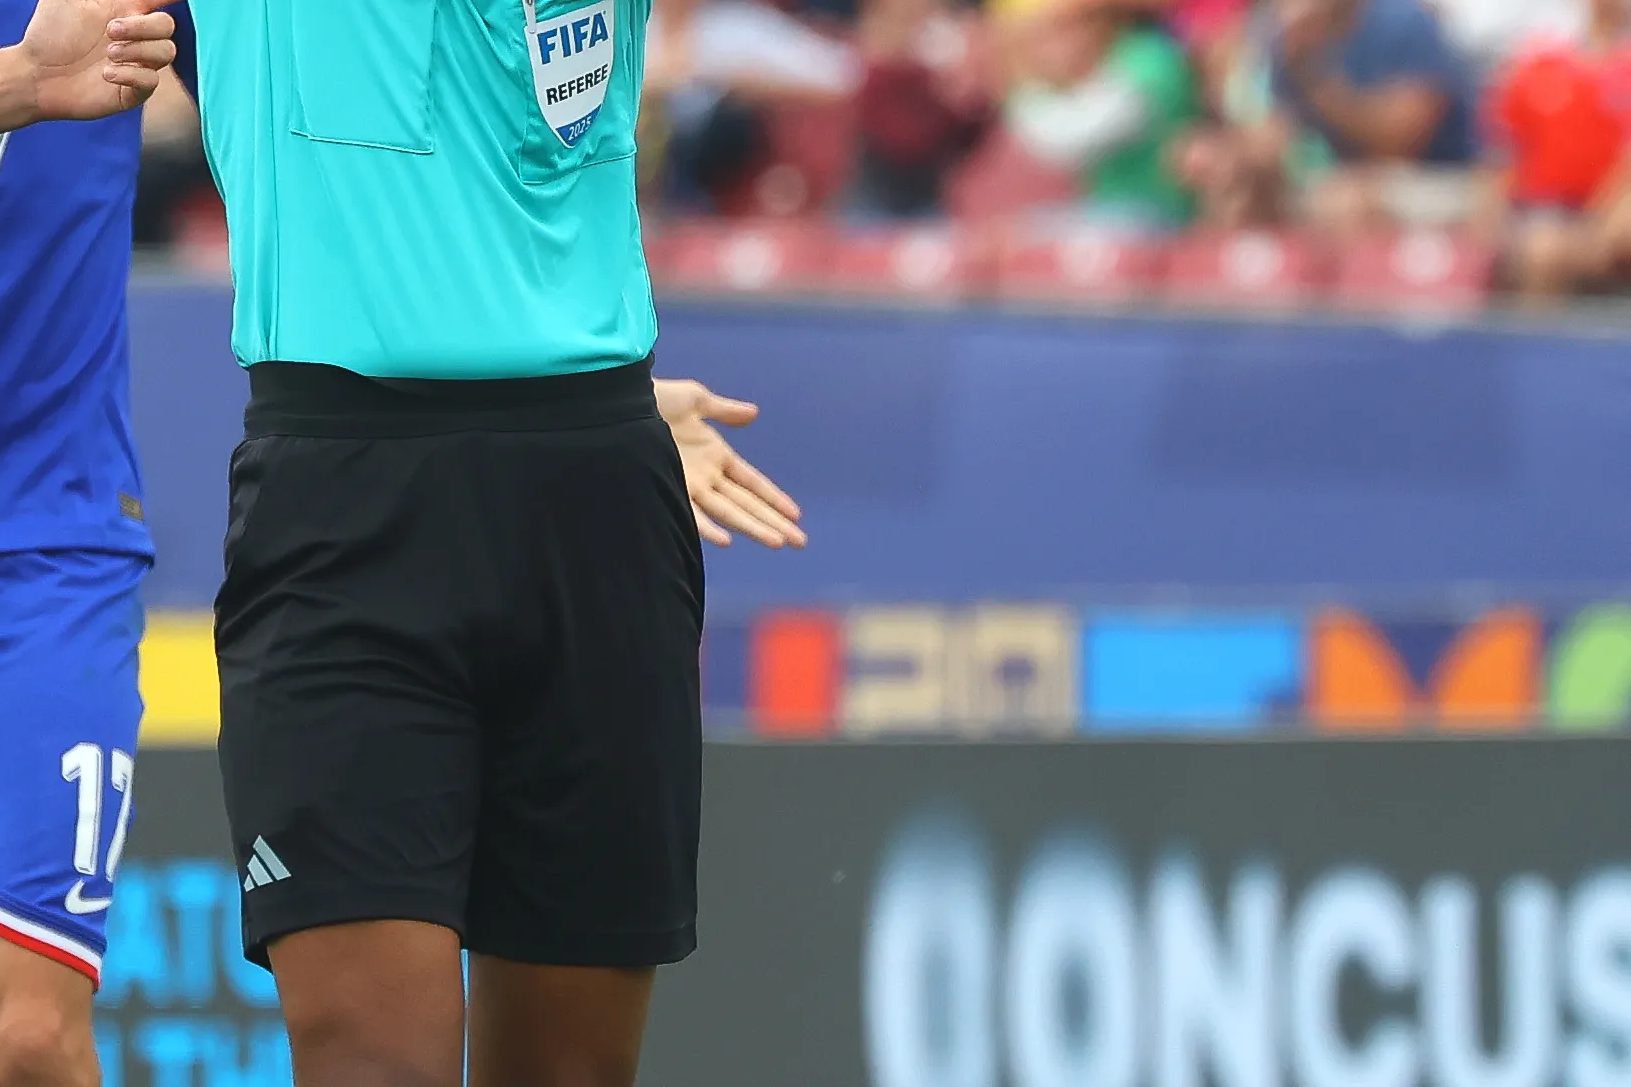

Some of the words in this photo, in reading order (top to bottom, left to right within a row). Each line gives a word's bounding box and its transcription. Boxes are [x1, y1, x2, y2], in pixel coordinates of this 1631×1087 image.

[537, 12, 609, 66] FIFA
[546, 64, 609, 106] REFEREE
[568, 115, 592, 141] 2025
[61, 741, 135, 883] 17
